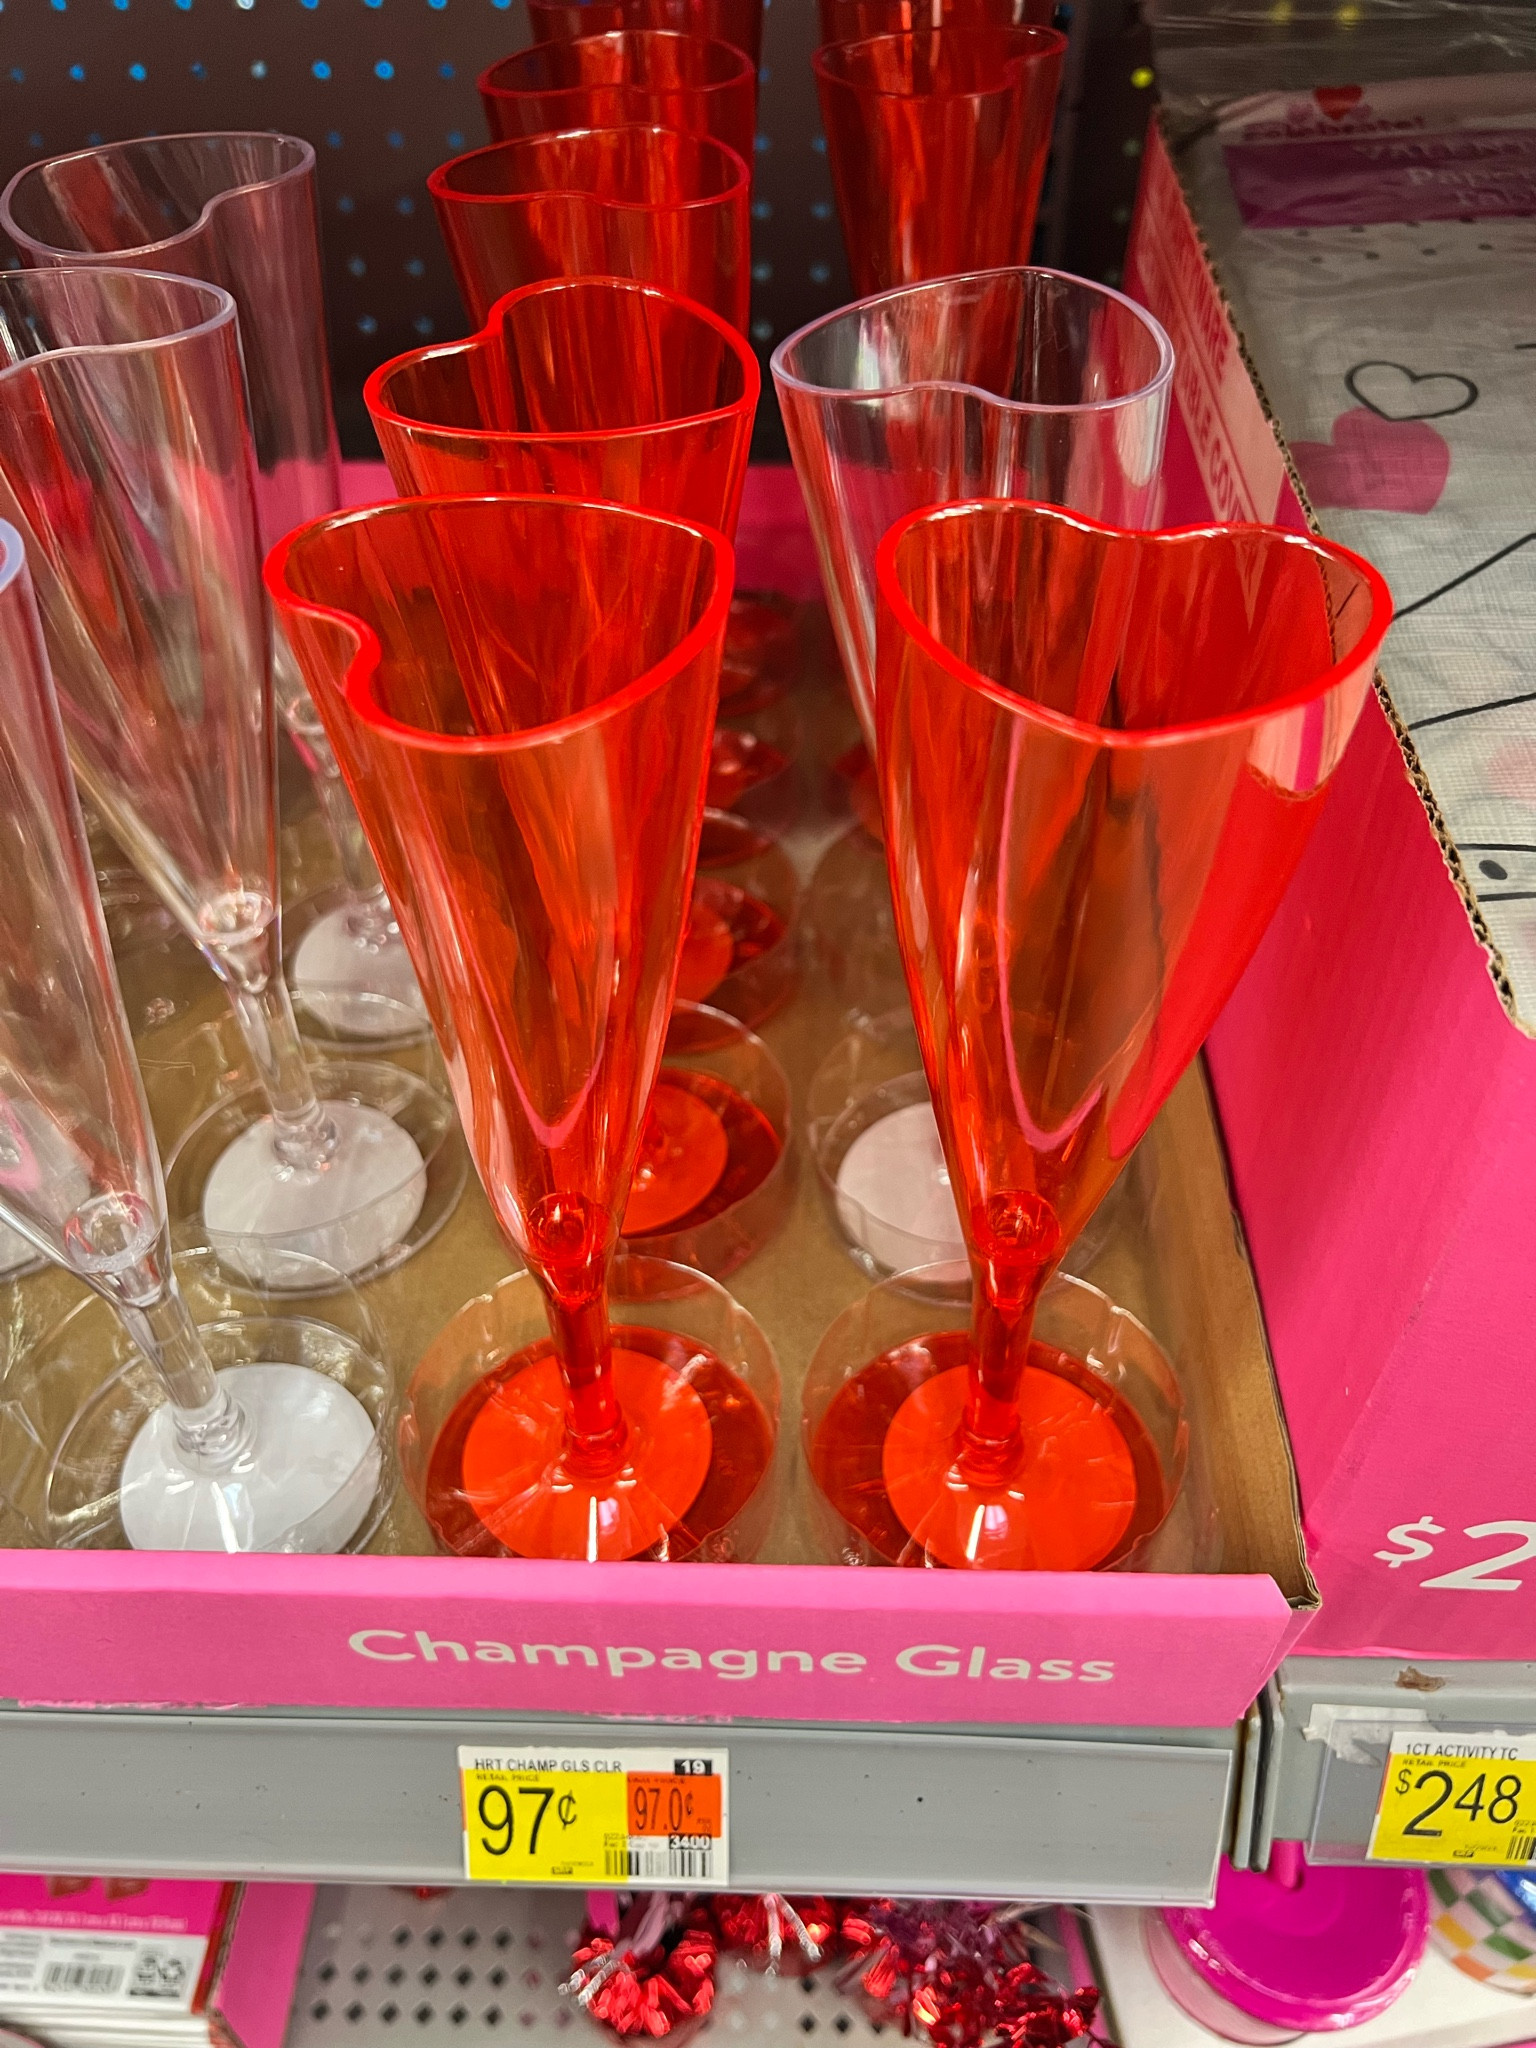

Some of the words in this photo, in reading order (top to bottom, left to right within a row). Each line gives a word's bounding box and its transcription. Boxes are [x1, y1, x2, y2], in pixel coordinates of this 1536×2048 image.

[349, 1629, 867, 1679] Champagne
[896, 1644, 1115, 1682] Glass
[1405, 1744, 1430, 1756] 1CT
[1434, 1744, 1497, 1759] ACTIVITY
[1501, 1747, 1519, 1760] TC
[475, 1759, 501, 1770] HRT
[507, 1759, 557, 1772] CHAMP
[561, 1760, 589, 1773] GLS
[594, 1761, 621, 1773] CLR
[681, 1760, 706, 1774] 19
[1438, 1760, 1467, 1768] PRICE
[670, 1834, 711, 1850] 3400
